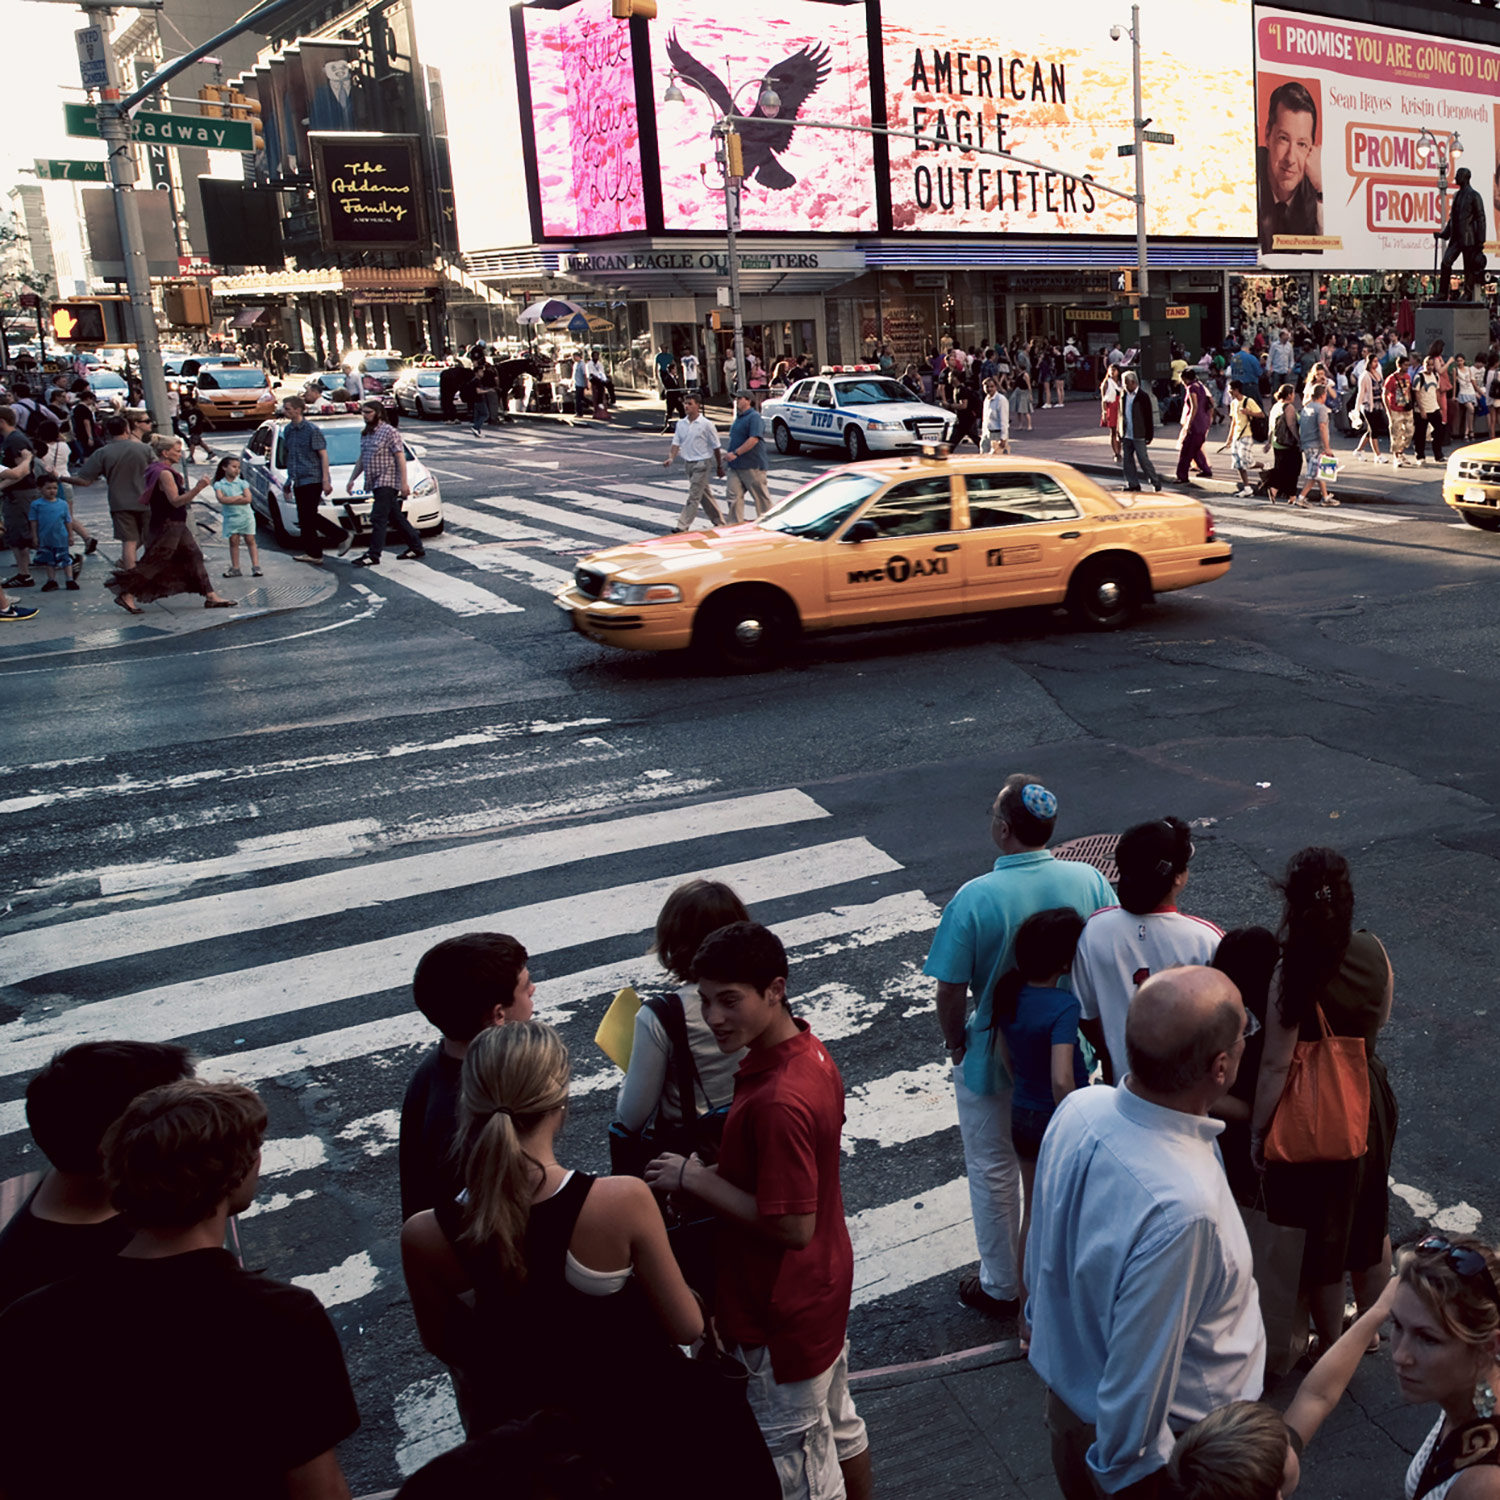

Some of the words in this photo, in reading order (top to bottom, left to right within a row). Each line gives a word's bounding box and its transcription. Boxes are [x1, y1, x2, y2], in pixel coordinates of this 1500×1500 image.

[78, 29, 99, 44] NYPD
[1286, 26, 1353, 61] PROMISE
[1353, 36, 1383, 64] YOU
[1386, 43, 1413, 69] ARE
[1416, 46, 1456, 77] GOING
[1458, 52, 1474, 78] TO
[911, 47, 1067, 105] AMERICAN
[1329, 86, 1356, 110] Sean
[1359, 91, 1392, 115] Hayes
[1401, 94, 1435, 117] Kristin
[1437, 98, 1489, 123] Chenoweth
[913, 106, 1012, 156] EAGLE
[57, 161, 71, 178] 7
[84, 163, 98, 172] AV
[344, 161, 387, 176] The
[331, 177, 410, 193] Addams
[914, 165, 1096, 214] OUTFITTERS
[340, 197, 408, 221] Family
[1375, 189, 1454, 224] PROMISE
[565, 255, 628, 271] MERICAN
[635, 254, 694, 270] EAGLE
[699, 253, 819, 269] OUTERS
[811, 411, 834, 428] NYPD
[847, 568, 885, 584] NYC
[886, 555, 949, 583] TAXI
